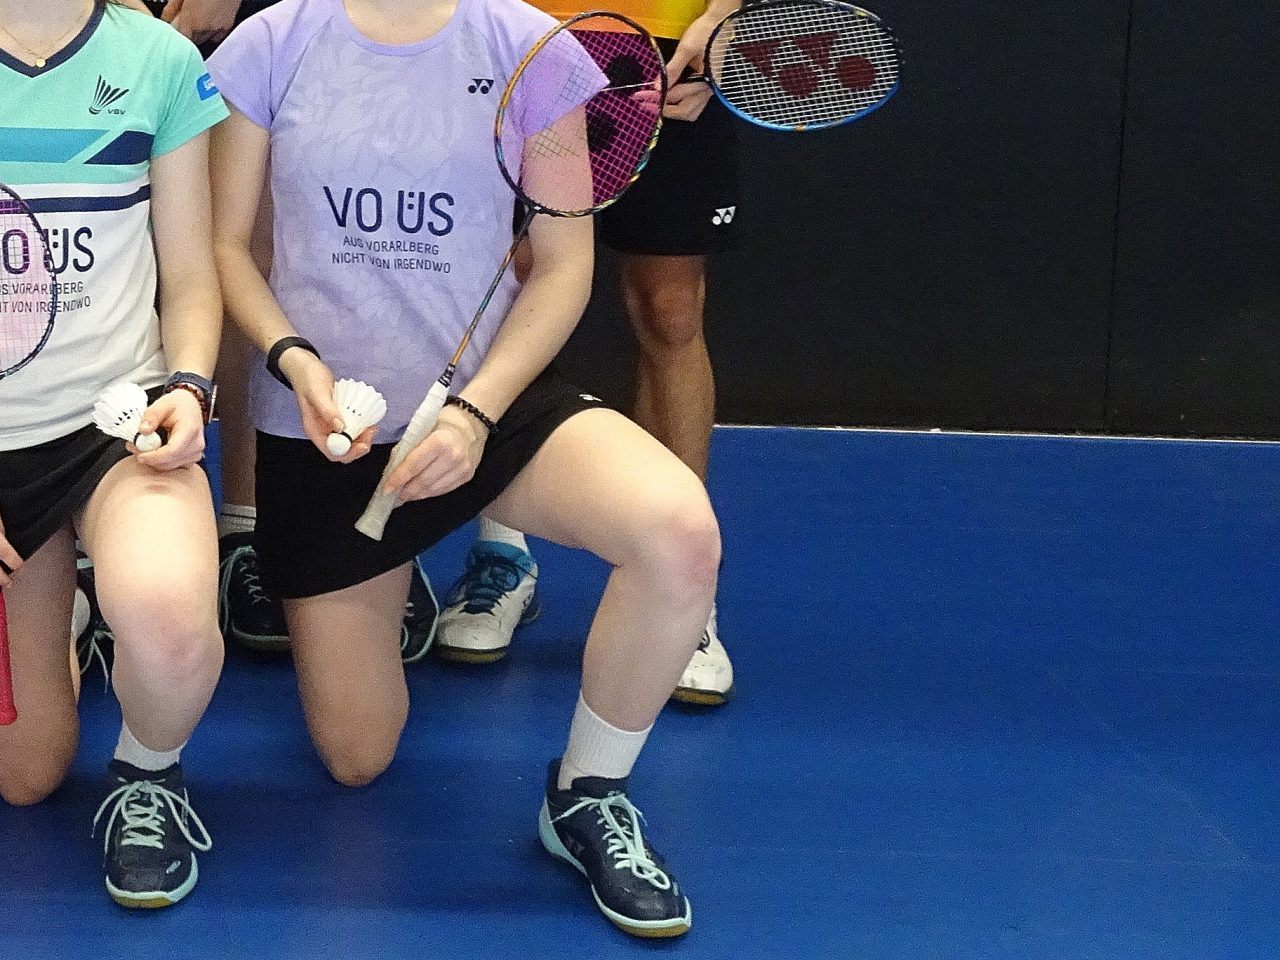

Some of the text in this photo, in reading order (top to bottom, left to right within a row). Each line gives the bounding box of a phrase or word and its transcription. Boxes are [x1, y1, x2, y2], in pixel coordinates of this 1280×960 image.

[323, 186, 455, 237] VO ÜS
[43, 227, 95, 275] ÜS
[343, 236, 439, 255] AUS VORARLBERG
[332, 253, 451, 274] NICHT VON IRGENDWO
[12, 301, 33, 313] VON
